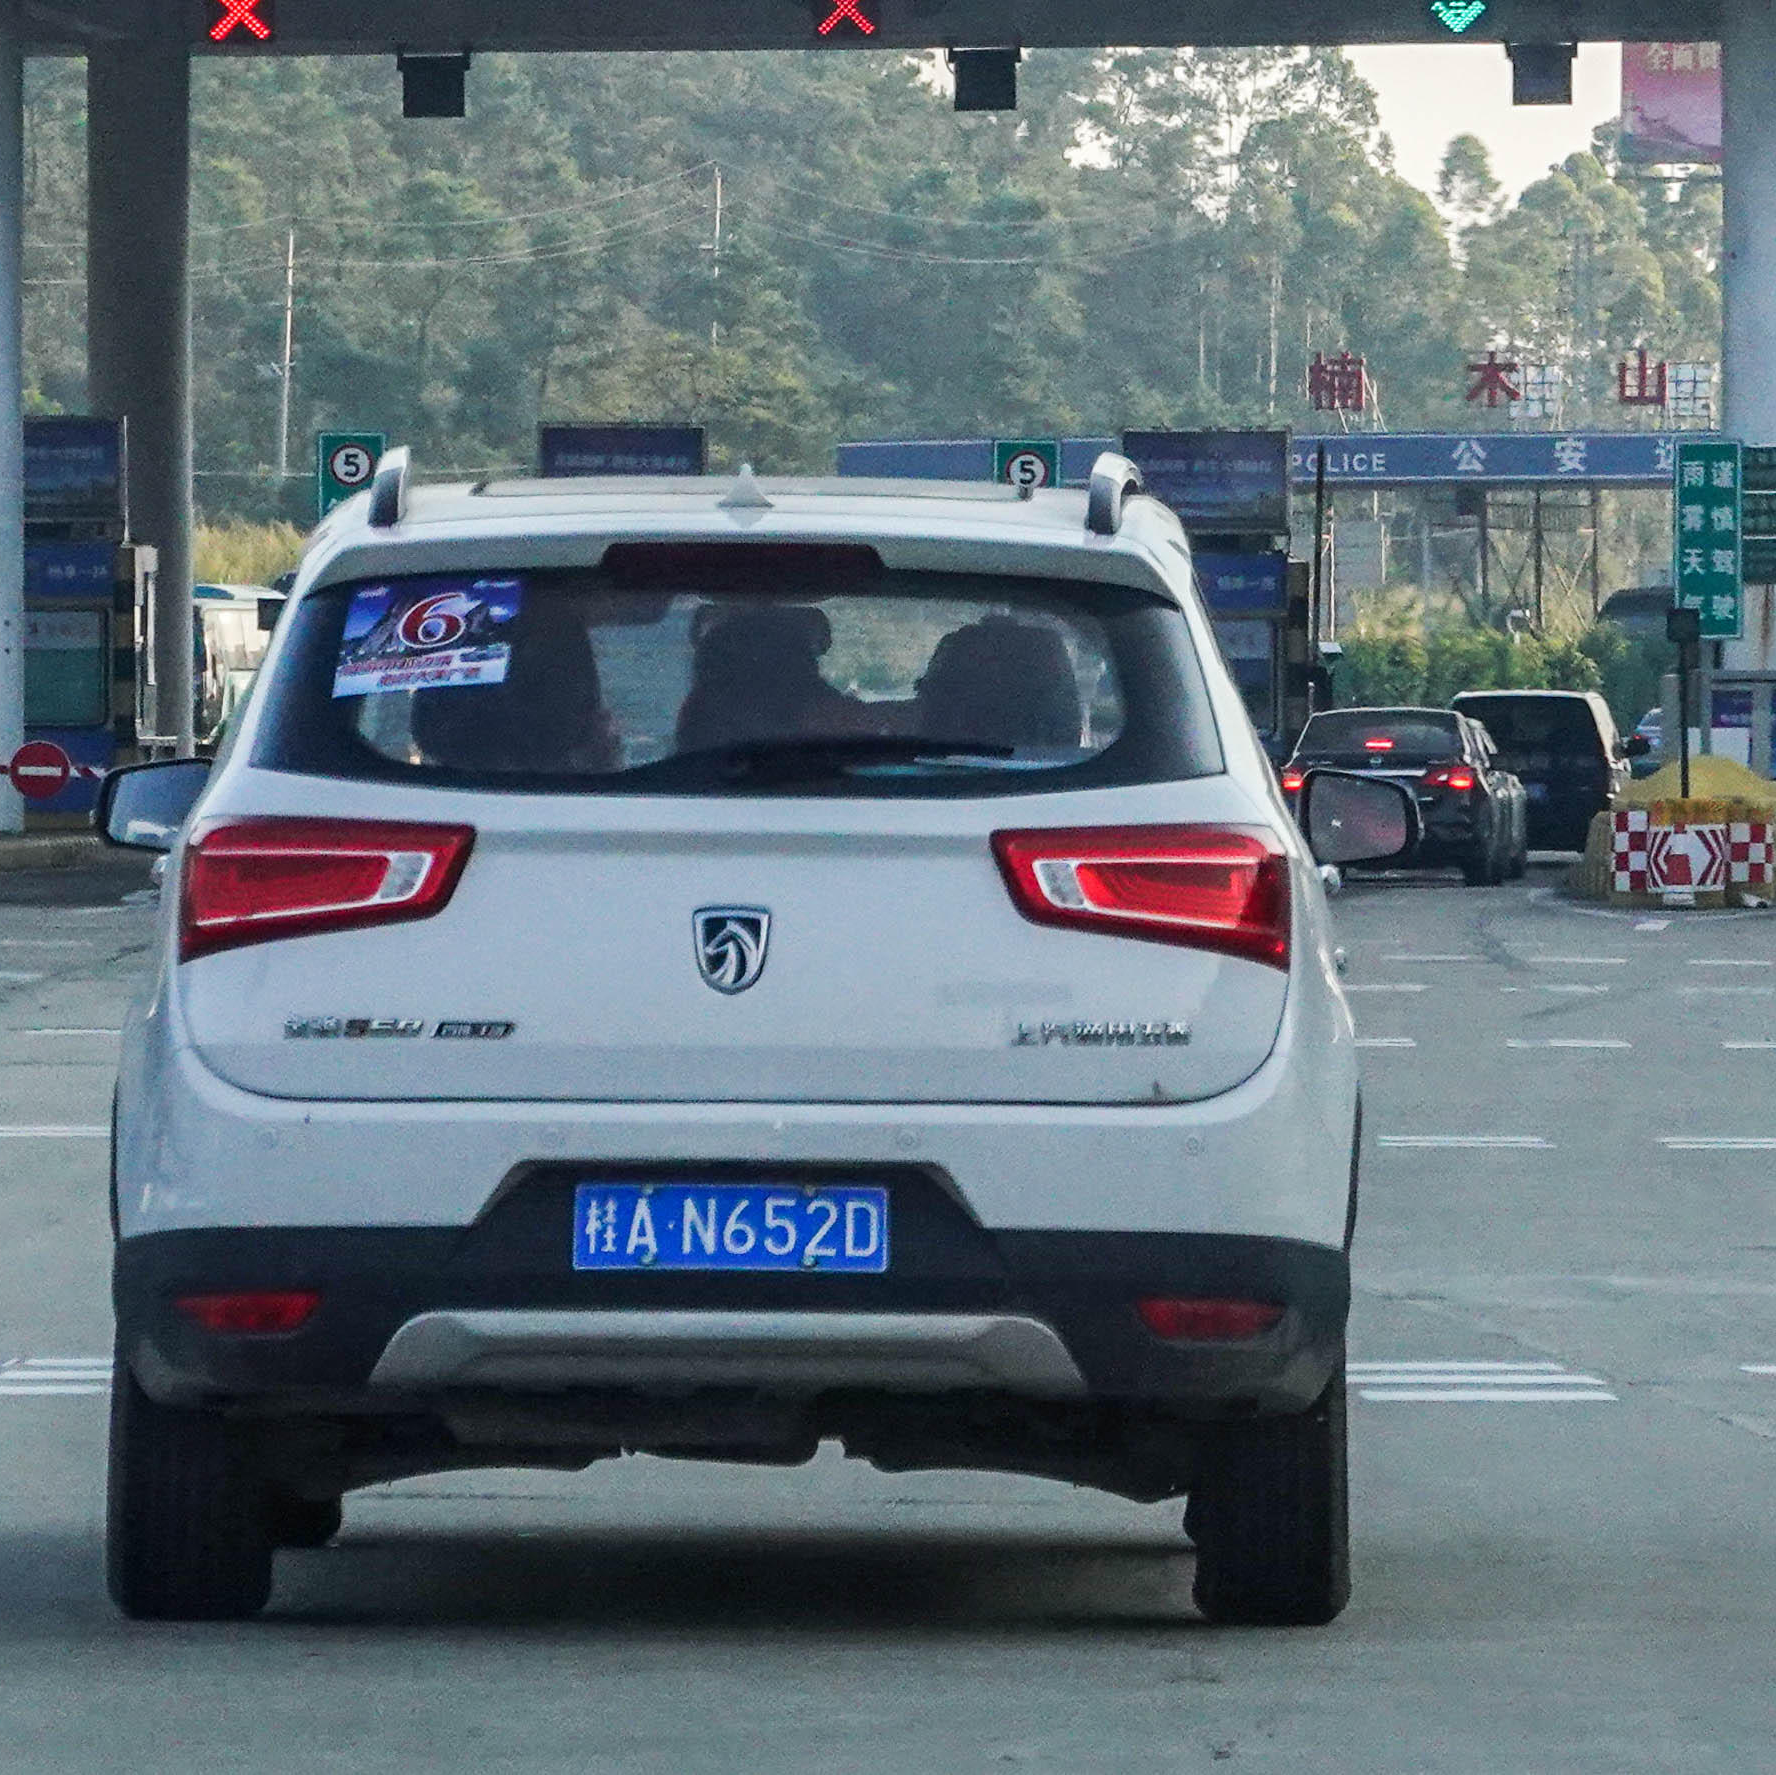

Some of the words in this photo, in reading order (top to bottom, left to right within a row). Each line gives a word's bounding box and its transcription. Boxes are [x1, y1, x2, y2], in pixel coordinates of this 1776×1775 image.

[344, 453, 361, 477] 5
[1019, 460, 1036, 485] 5
[1291, 452, 1386, 473] POLICE
[398, 592, 466, 648] 6
